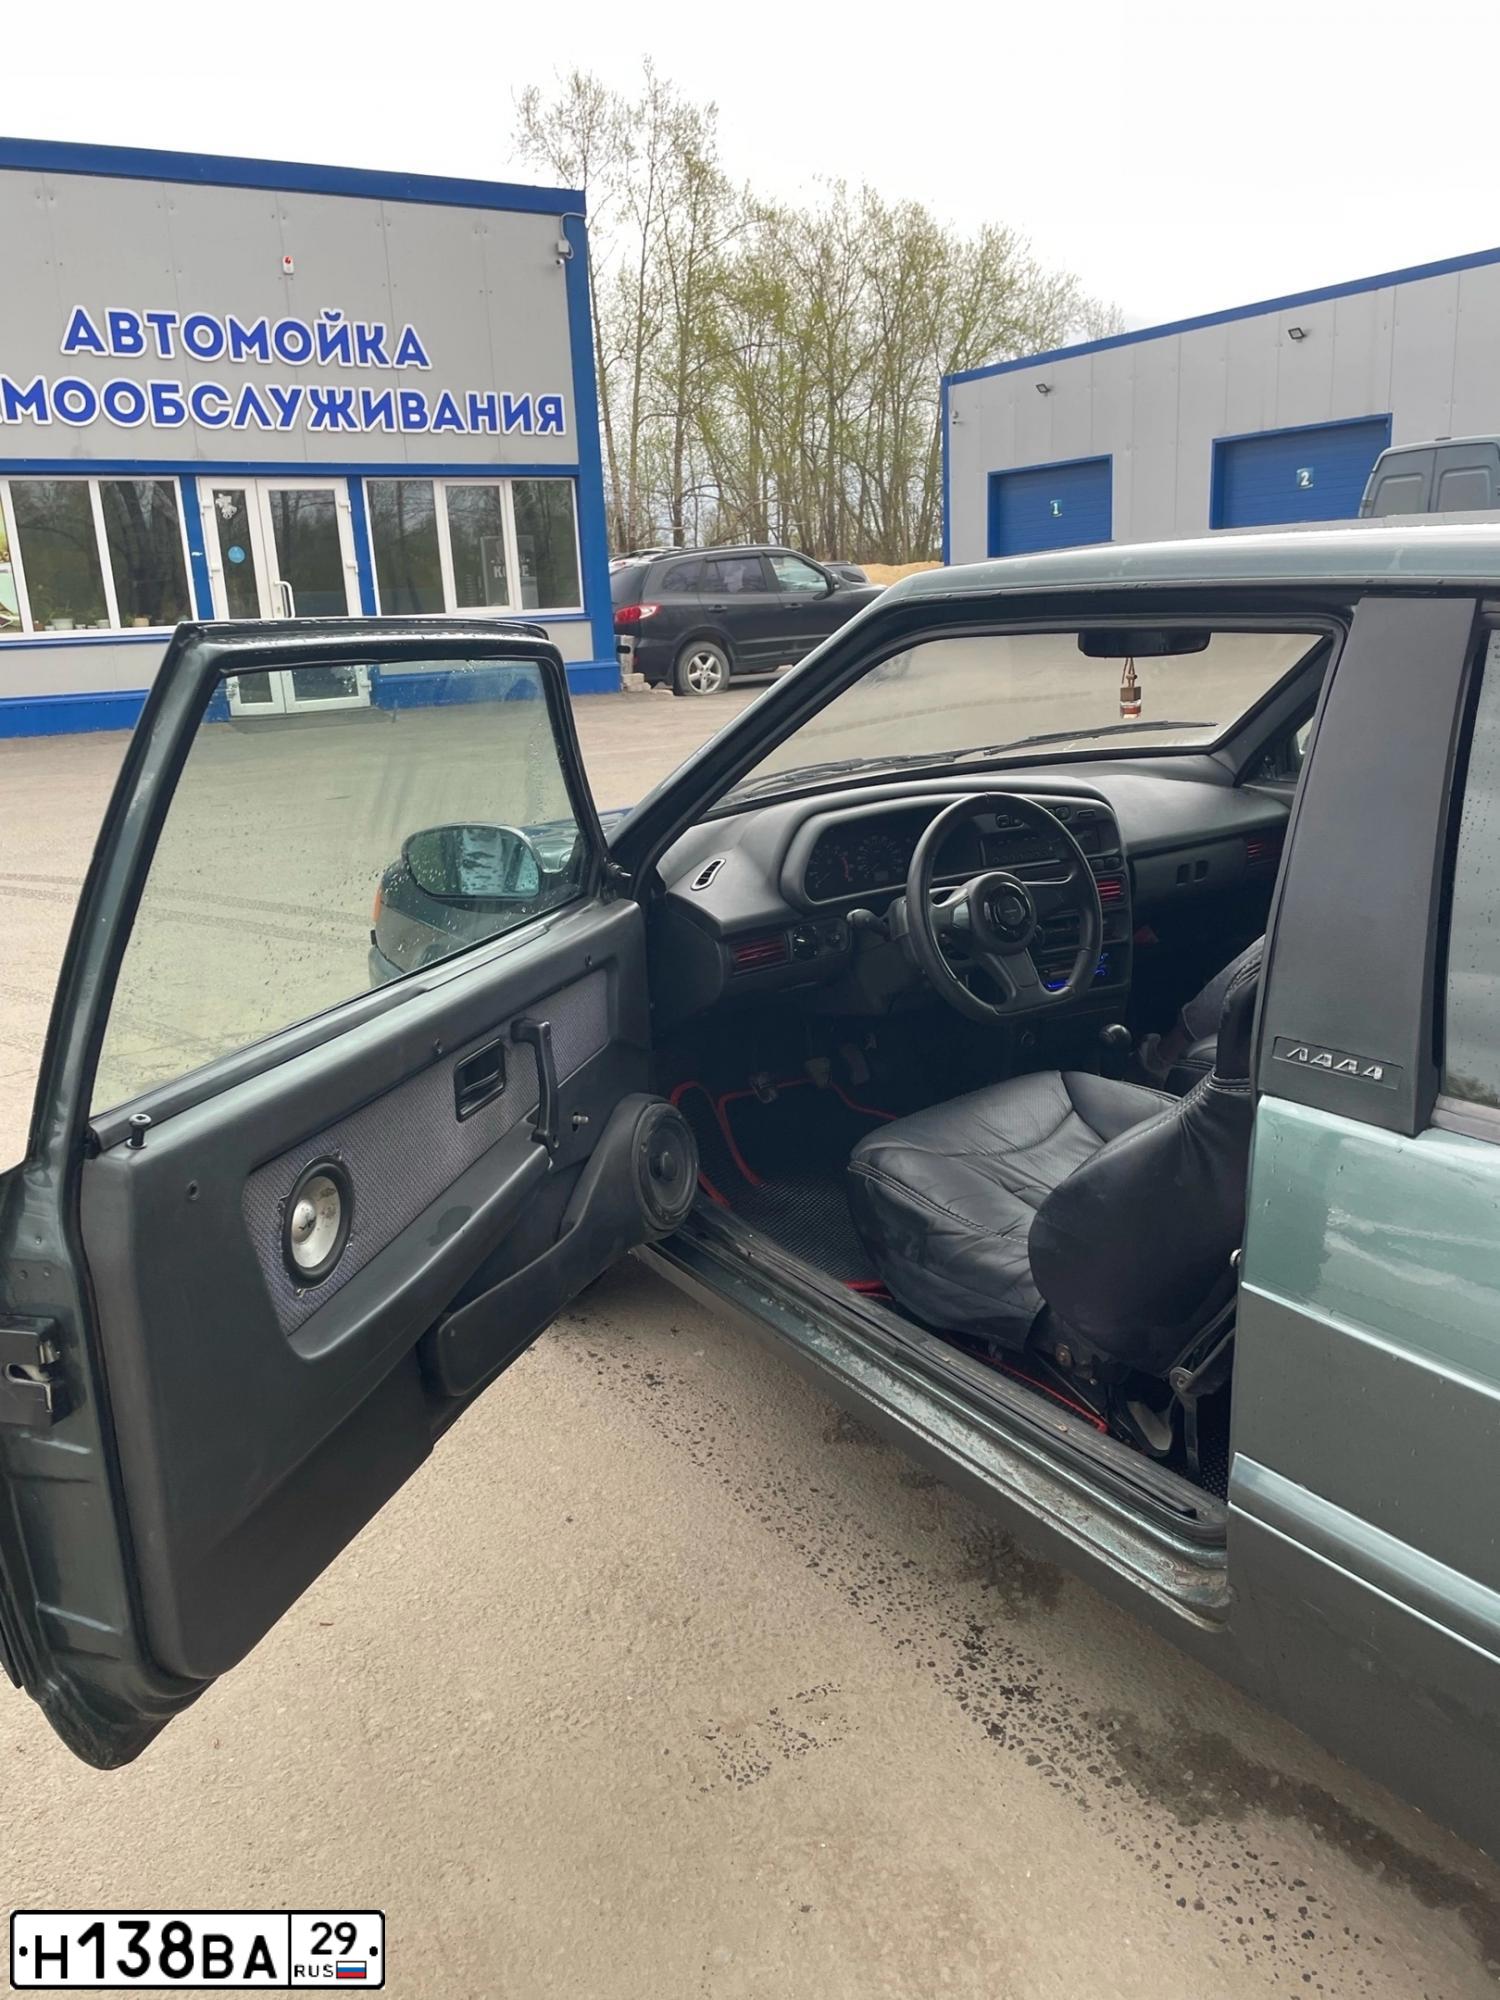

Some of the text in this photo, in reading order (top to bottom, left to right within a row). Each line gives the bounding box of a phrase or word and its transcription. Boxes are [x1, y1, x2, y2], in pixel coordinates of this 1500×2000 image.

[61, 306, 432, 369] АВТОМОЙКА
[0, 374, 567, 435] МООБСЛУЖИВАНИЯ
[1299, 470, 1311, 487] 2
